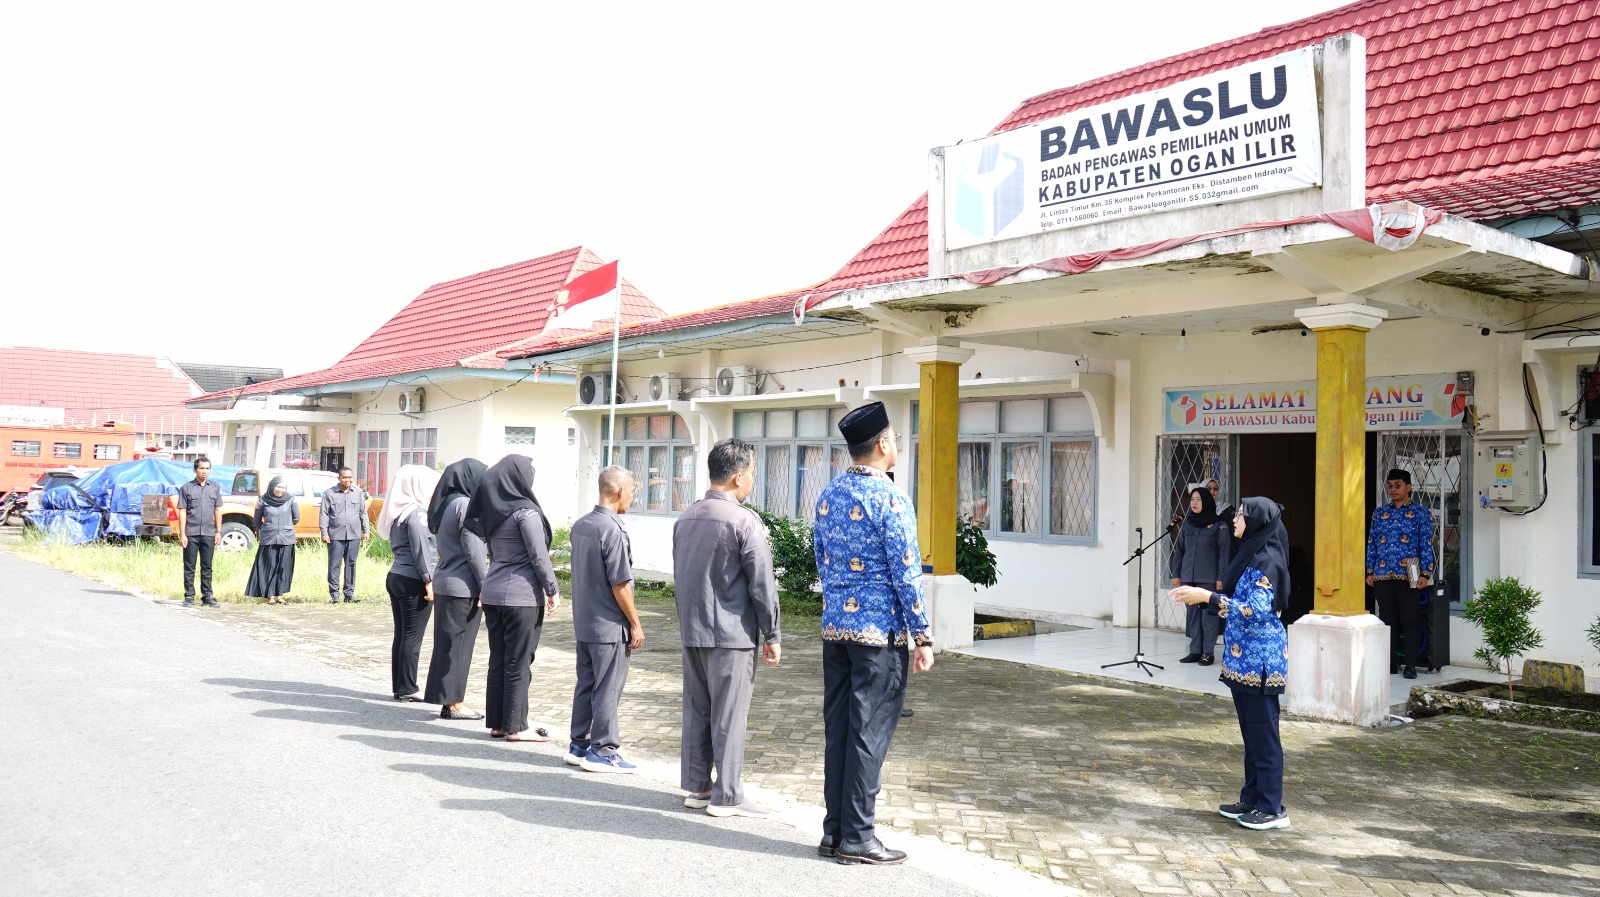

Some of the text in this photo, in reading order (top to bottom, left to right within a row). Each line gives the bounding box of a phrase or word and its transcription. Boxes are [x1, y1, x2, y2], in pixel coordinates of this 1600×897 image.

[1040, 64, 1288, 162] BAWASLU
[1039, 133, 1297, 203] KABUPATEN OGAN ILIR
[1041, 114, 1292, 182] BADAN PENGAWAS PEMILIHAN UMUM
[1049, 208, 1069, 217] Lintas
[1070, 204, 1089, 212] Timur
[1114, 193, 1145, 204] Komplek
[1146, 186, 1190, 199] Perkantoran
[1192, 182, 1208, 190] Eks.
[1210, 173, 1252, 187] Distamben
[1254, 166, 1293, 178] Indralaya
[1102, 207, 1122, 217] Email
[1202, 383, 1424, 410] SELAMAT ANG
[1203, 409, 1423, 427] Di BAWASLU Kabu gan Ilir
